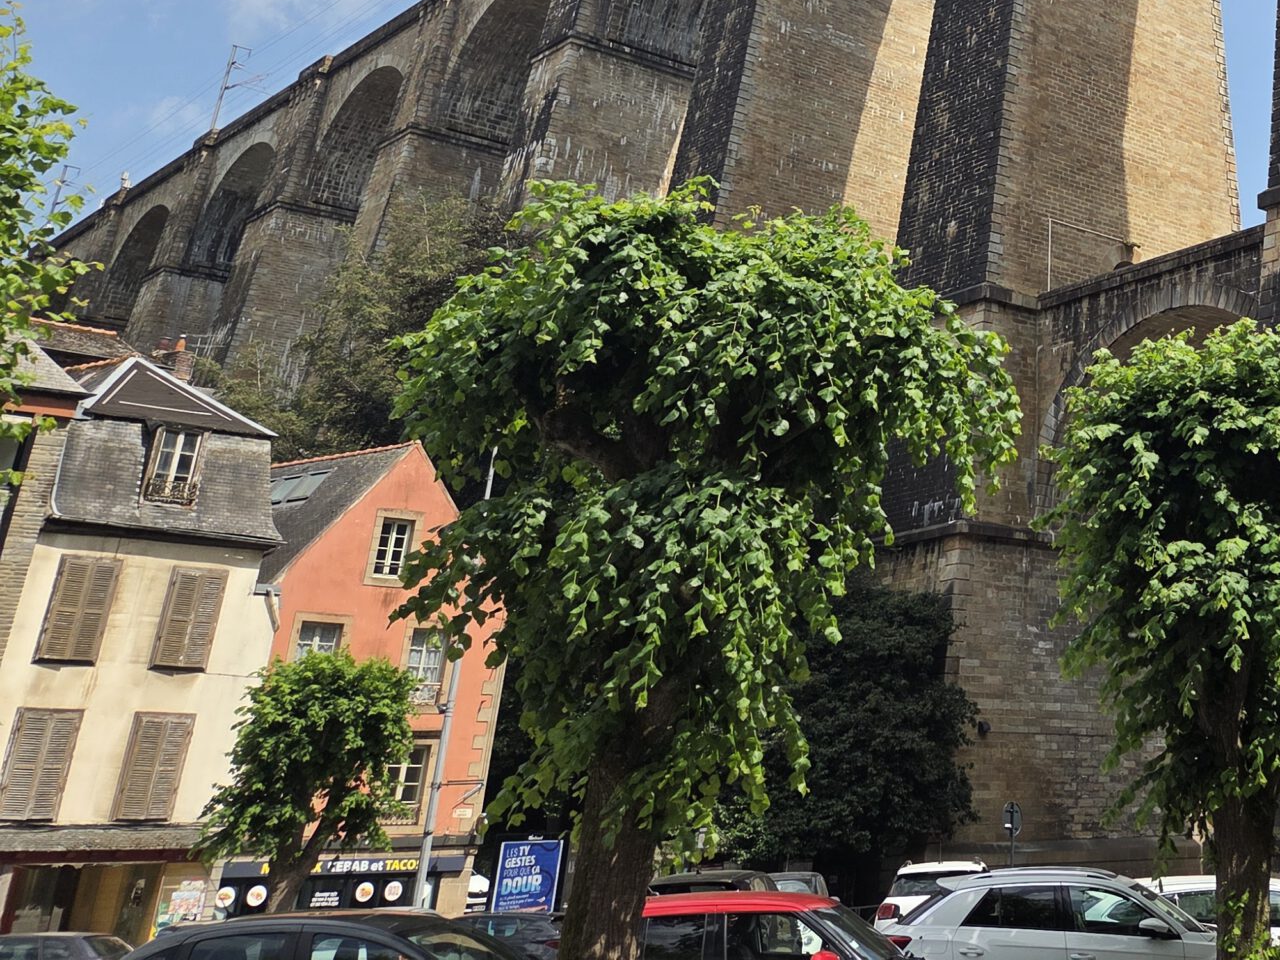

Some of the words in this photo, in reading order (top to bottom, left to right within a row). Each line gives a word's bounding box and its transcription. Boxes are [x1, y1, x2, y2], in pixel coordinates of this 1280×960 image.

[506, 847, 518, 858] LES
[519, 844, 531, 856] TY
[370, 860, 384, 871] et
[505, 855, 536, 869] GESTES
[503, 868, 519, 878] POUR
[520, 866, 531, 876] QUE
[501, 874, 542, 896] DOUR
